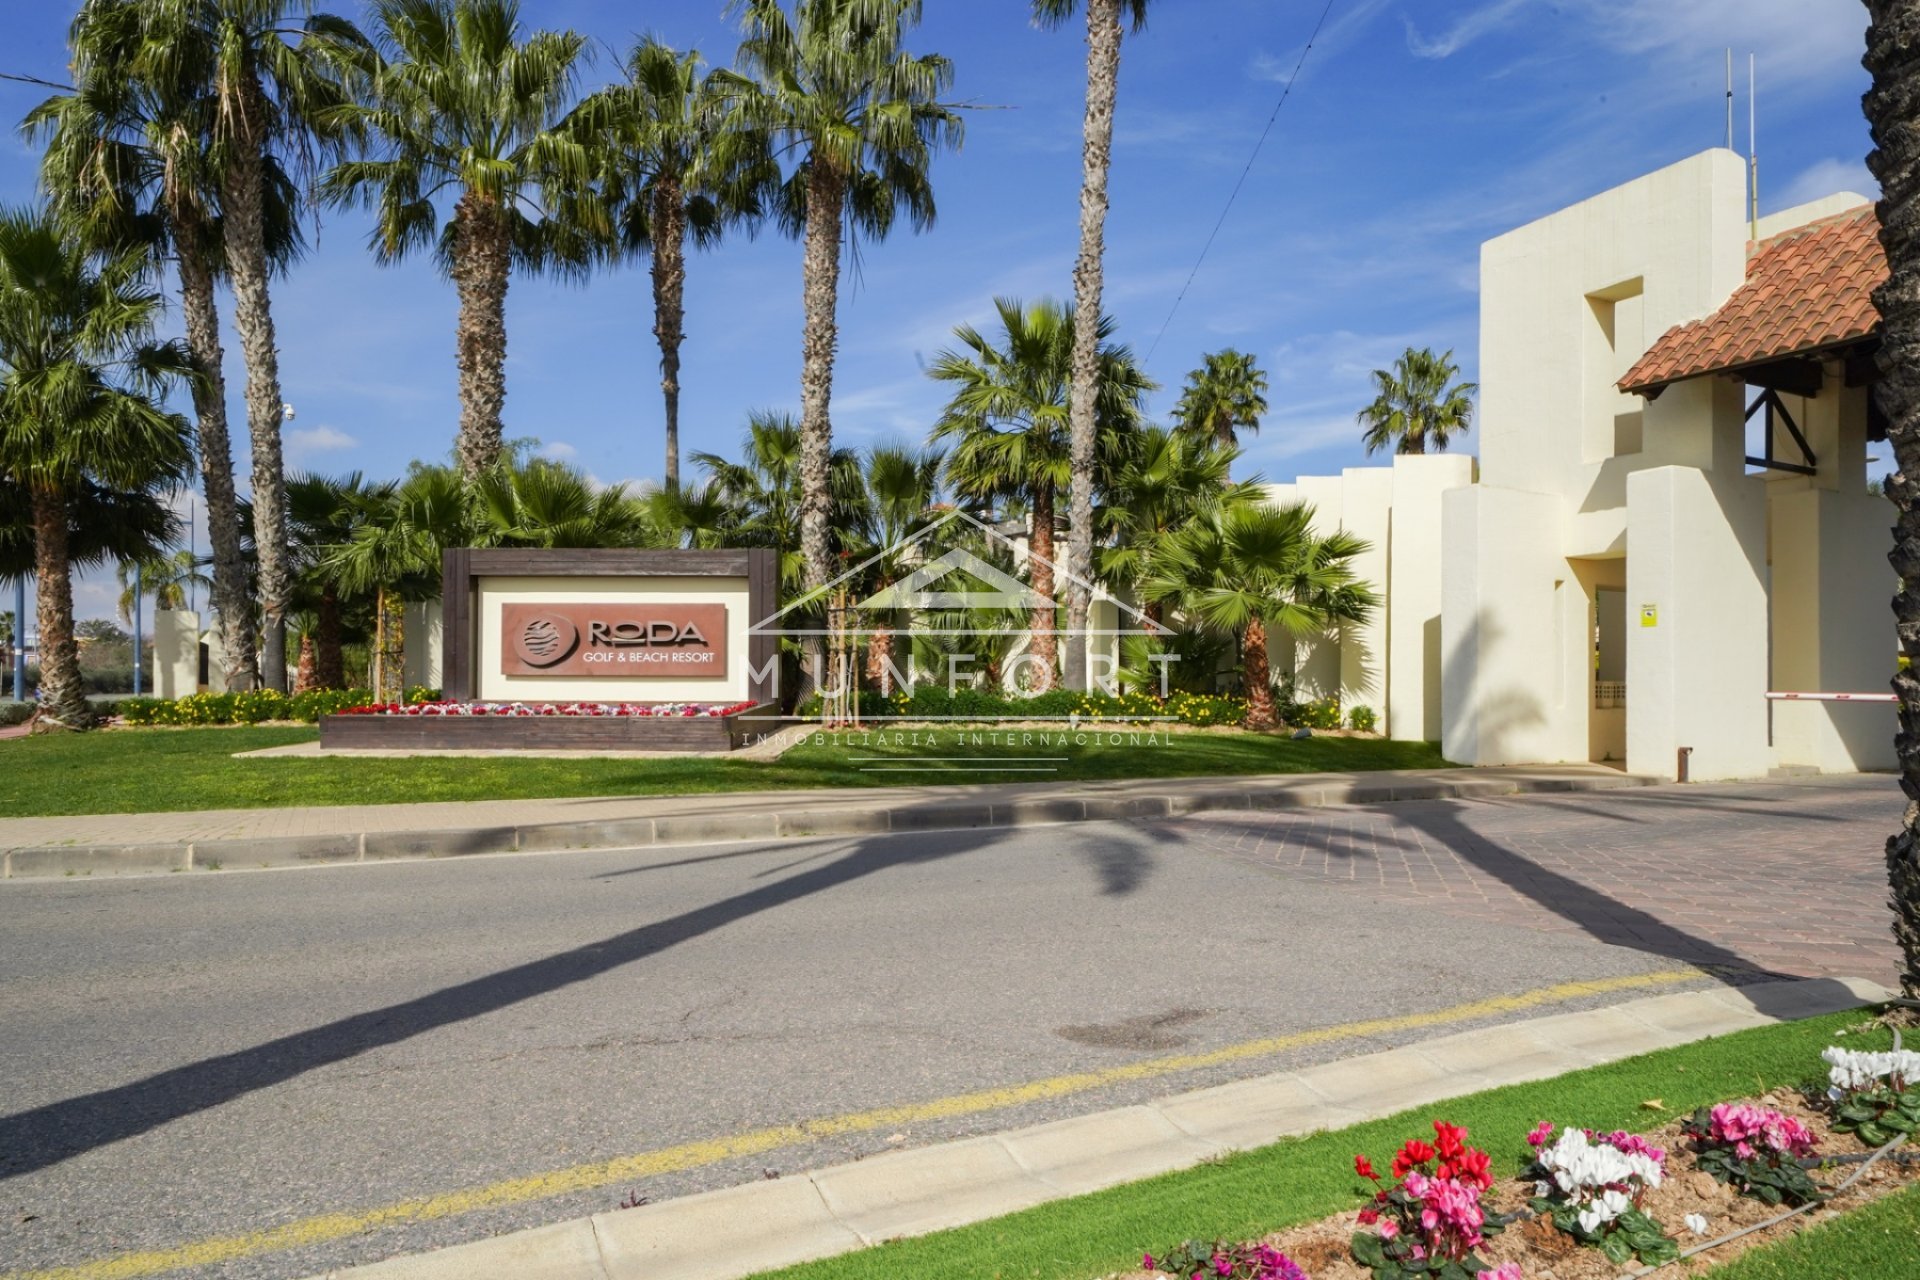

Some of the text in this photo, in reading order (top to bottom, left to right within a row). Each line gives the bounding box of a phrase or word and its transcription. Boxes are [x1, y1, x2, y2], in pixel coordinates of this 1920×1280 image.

[588, 620, 706, 644] RODA
[583, 652, 714, 662] GOLF & BEACH RESORT
